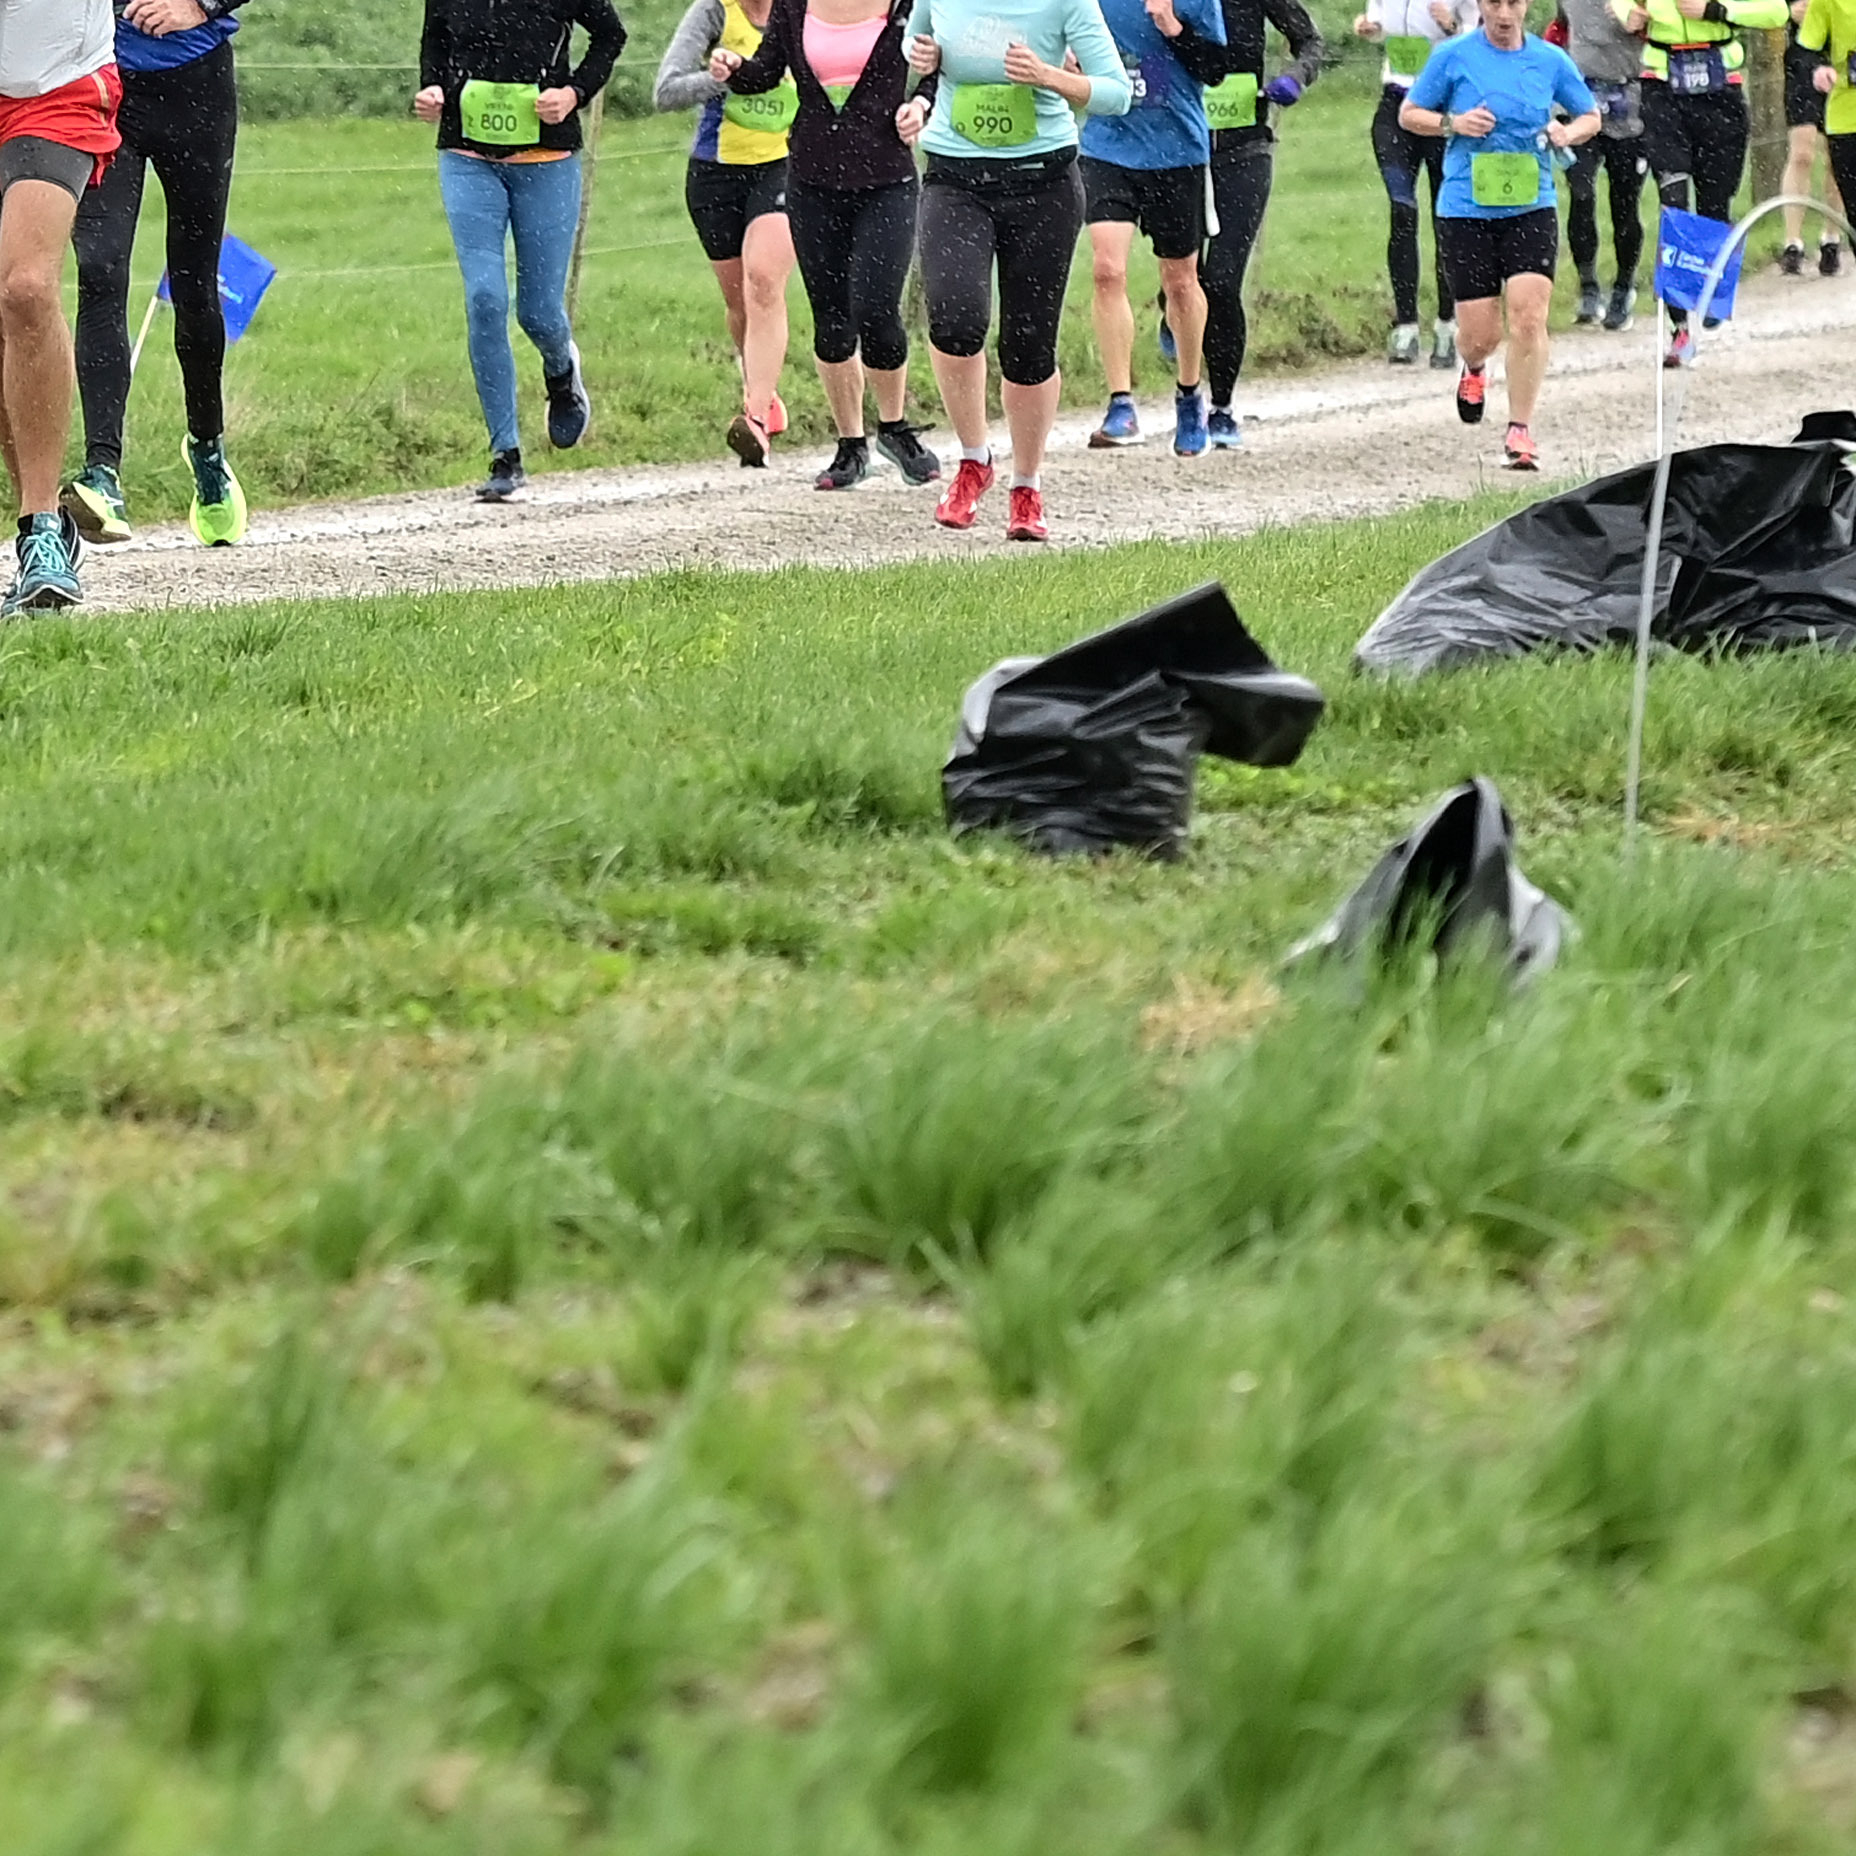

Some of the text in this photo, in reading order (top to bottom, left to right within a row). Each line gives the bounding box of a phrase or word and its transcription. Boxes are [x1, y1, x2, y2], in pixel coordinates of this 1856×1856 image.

[741, 97, 785, 117] 3051
[1207, 101, 1239, 118] 966
[480, 113, 517, 132] 800
[973, 116, 1013, 134] 990
[1503, 179, 1513, 194] 6
